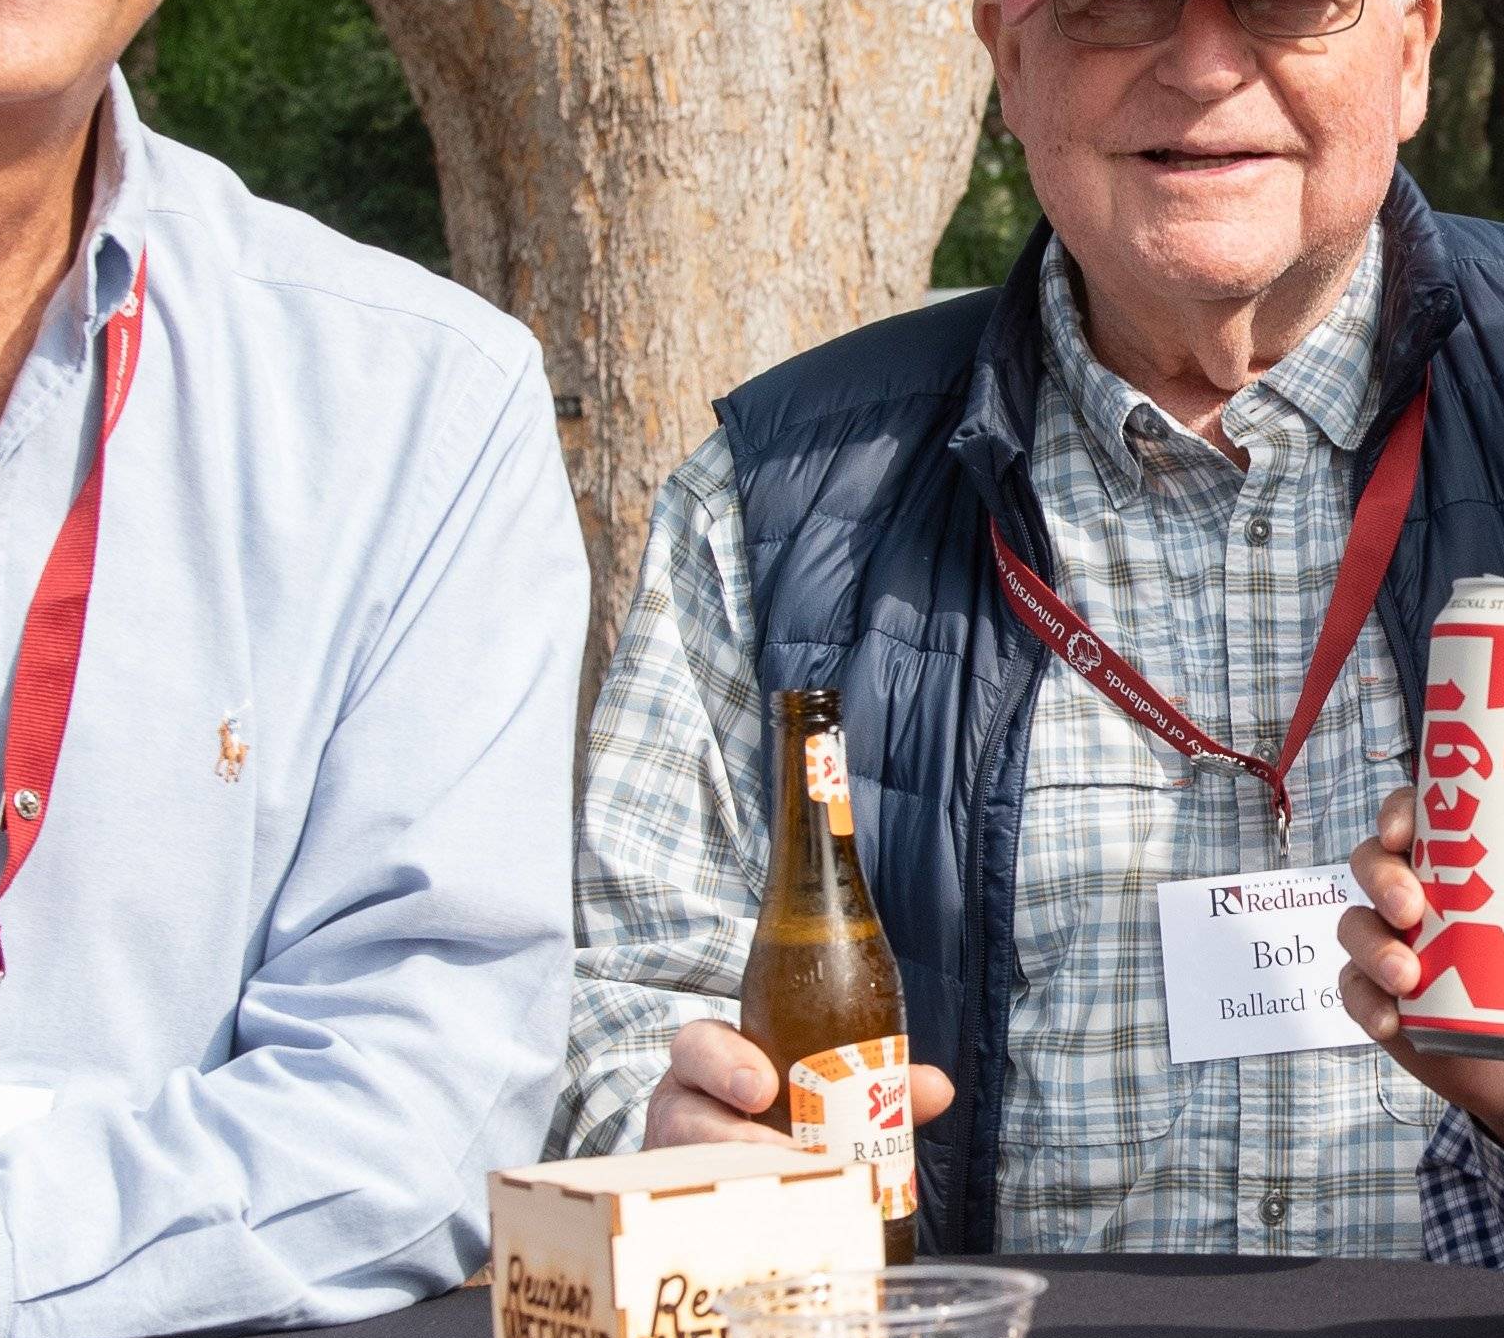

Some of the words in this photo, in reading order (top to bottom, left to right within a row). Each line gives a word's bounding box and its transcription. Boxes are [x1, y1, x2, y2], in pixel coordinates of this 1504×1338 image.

[1006, 572, 1065, 641] University
[1104, 667, 1167, 732] Redlands
[1167, 725, 1185, 741] of
[1246, 883, 1348, 913] Redlands
[1250, 934, 1316, 970] Bob
[1218, 988, 1306, 1021] Ballard
[868, 1077, 906, 1122] Stieg
[853, 1132, 914, 1161] RADLE
[507, 1254, 593, 1317] Reunion
